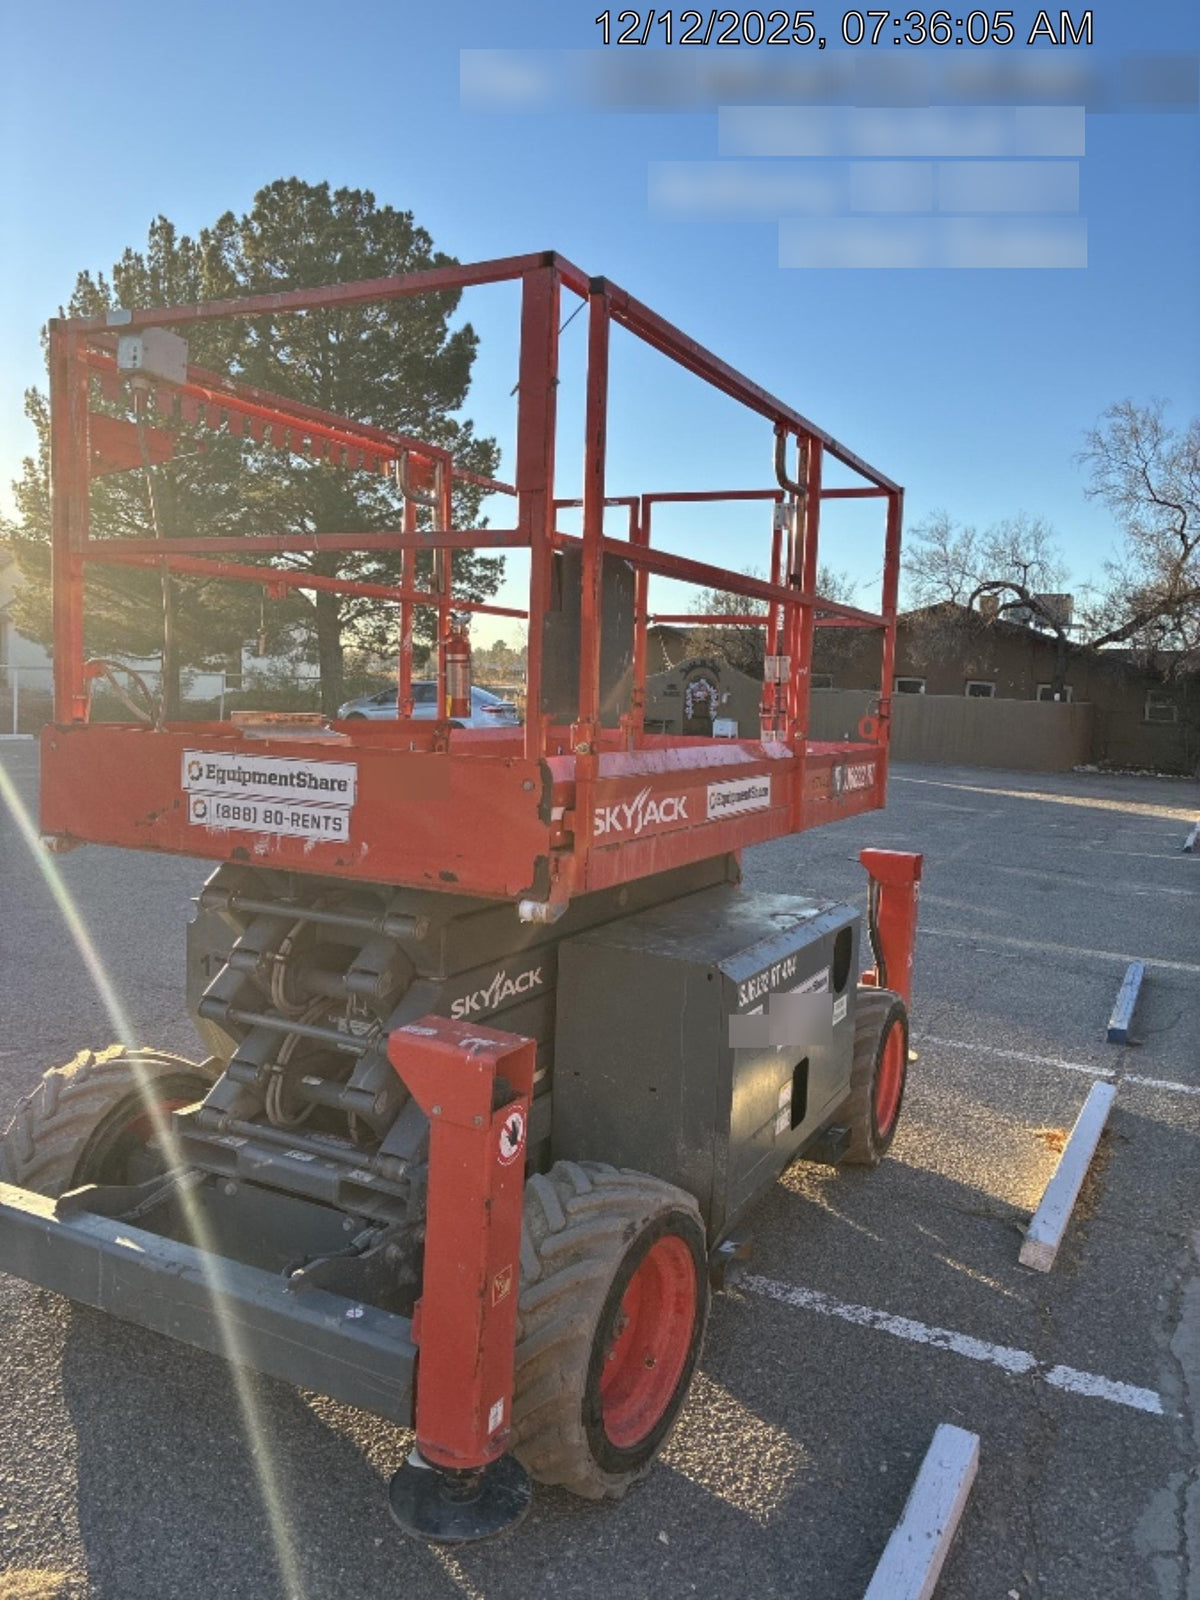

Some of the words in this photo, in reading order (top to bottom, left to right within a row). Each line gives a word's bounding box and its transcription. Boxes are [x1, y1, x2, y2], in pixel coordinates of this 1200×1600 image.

[205, 763, 349, 792] EquipmentShare
[215, 803, 257, 824] (888)
[262, 809, 343, 832] 80-RENTS
[593, 785, 689, 836] SKYJACK
[450, 969, 544, 1020] SKYJACK
